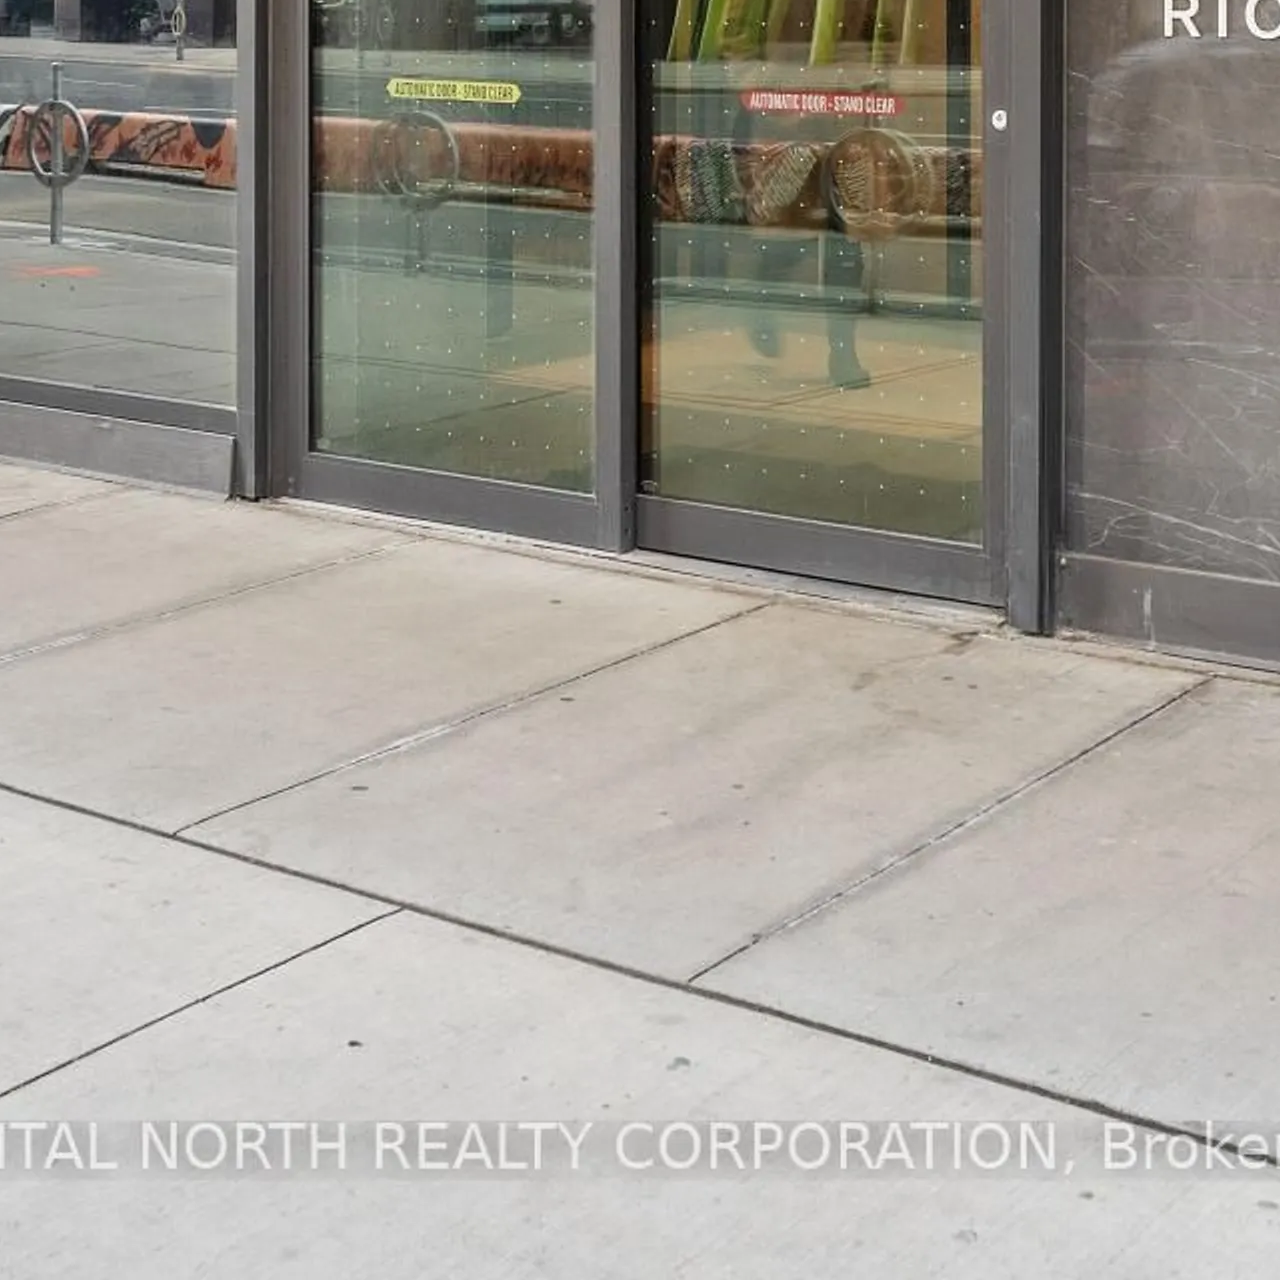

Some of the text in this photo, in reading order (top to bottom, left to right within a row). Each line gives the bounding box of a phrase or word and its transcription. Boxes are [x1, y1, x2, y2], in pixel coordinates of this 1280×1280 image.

[750, 92, 801, 110] AUTOMATIC
[802, 94, 827, 112] DOOR
[834, 96, 863, 113] STAND
[865, 97, 896, 114] CLEAR
